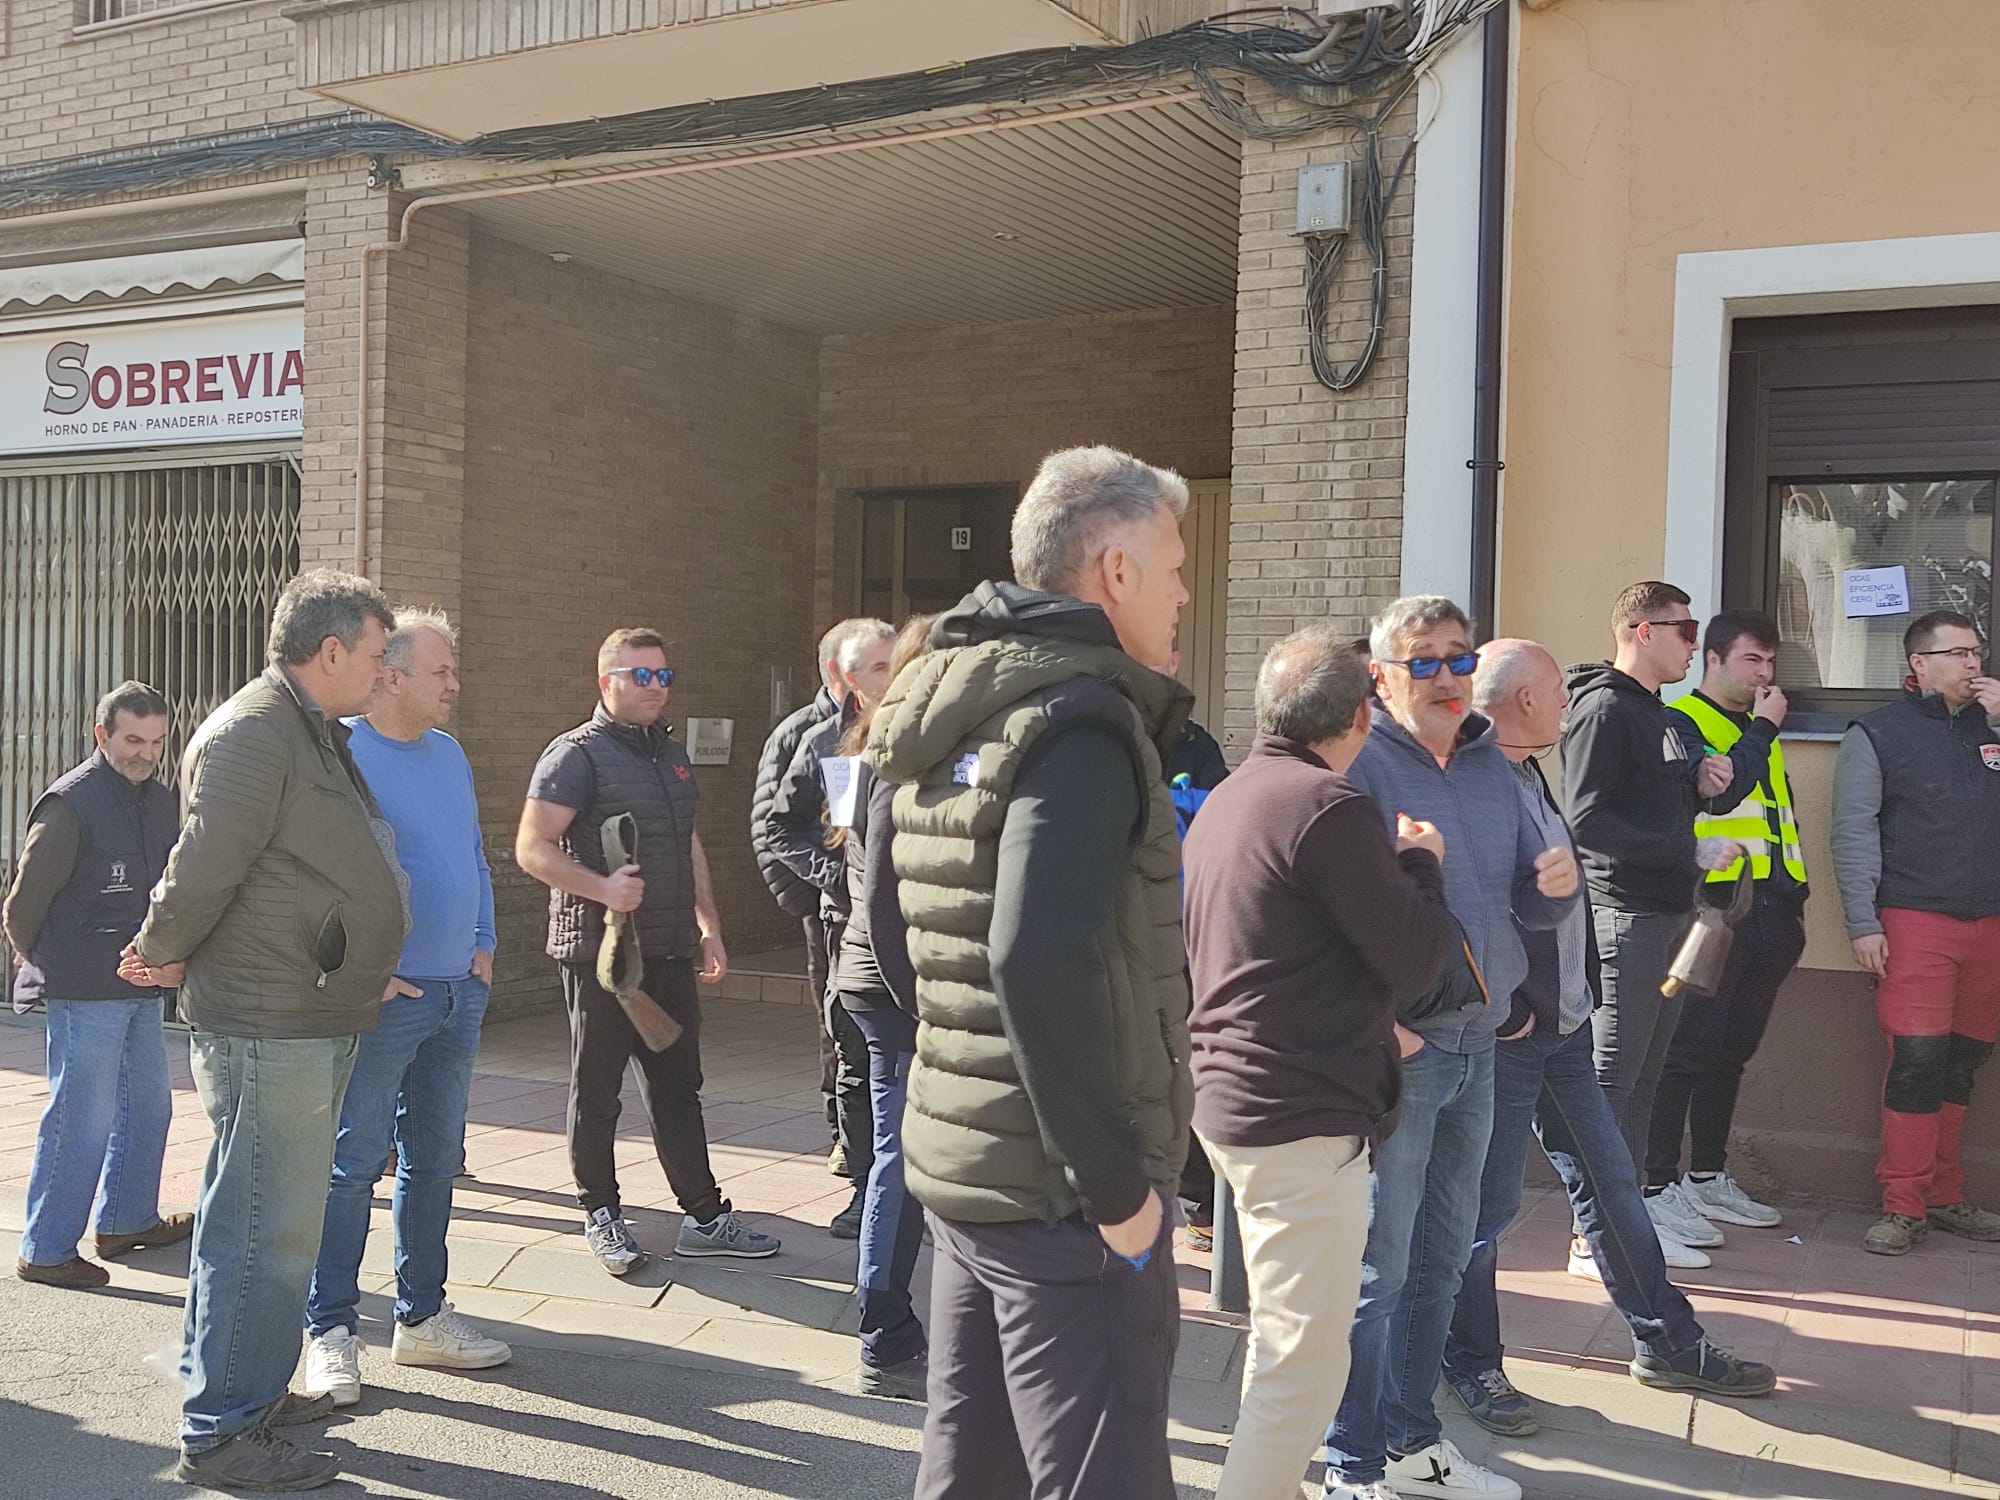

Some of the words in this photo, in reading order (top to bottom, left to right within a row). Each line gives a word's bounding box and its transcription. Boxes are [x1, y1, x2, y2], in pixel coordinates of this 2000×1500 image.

[45, 423, 88, 437] HORNO
[92, 421, 109, 434] DE
[113, 419, 138, 432] PAN
[146, 414, 218, 430] PANADERIA
[227, 408, 302, 425] REPOSTERI
[956, 530, 968, 545] 19
[1849, 574, 1871, 582] OCAS
[1850, 595, 1872, 603] CERO
